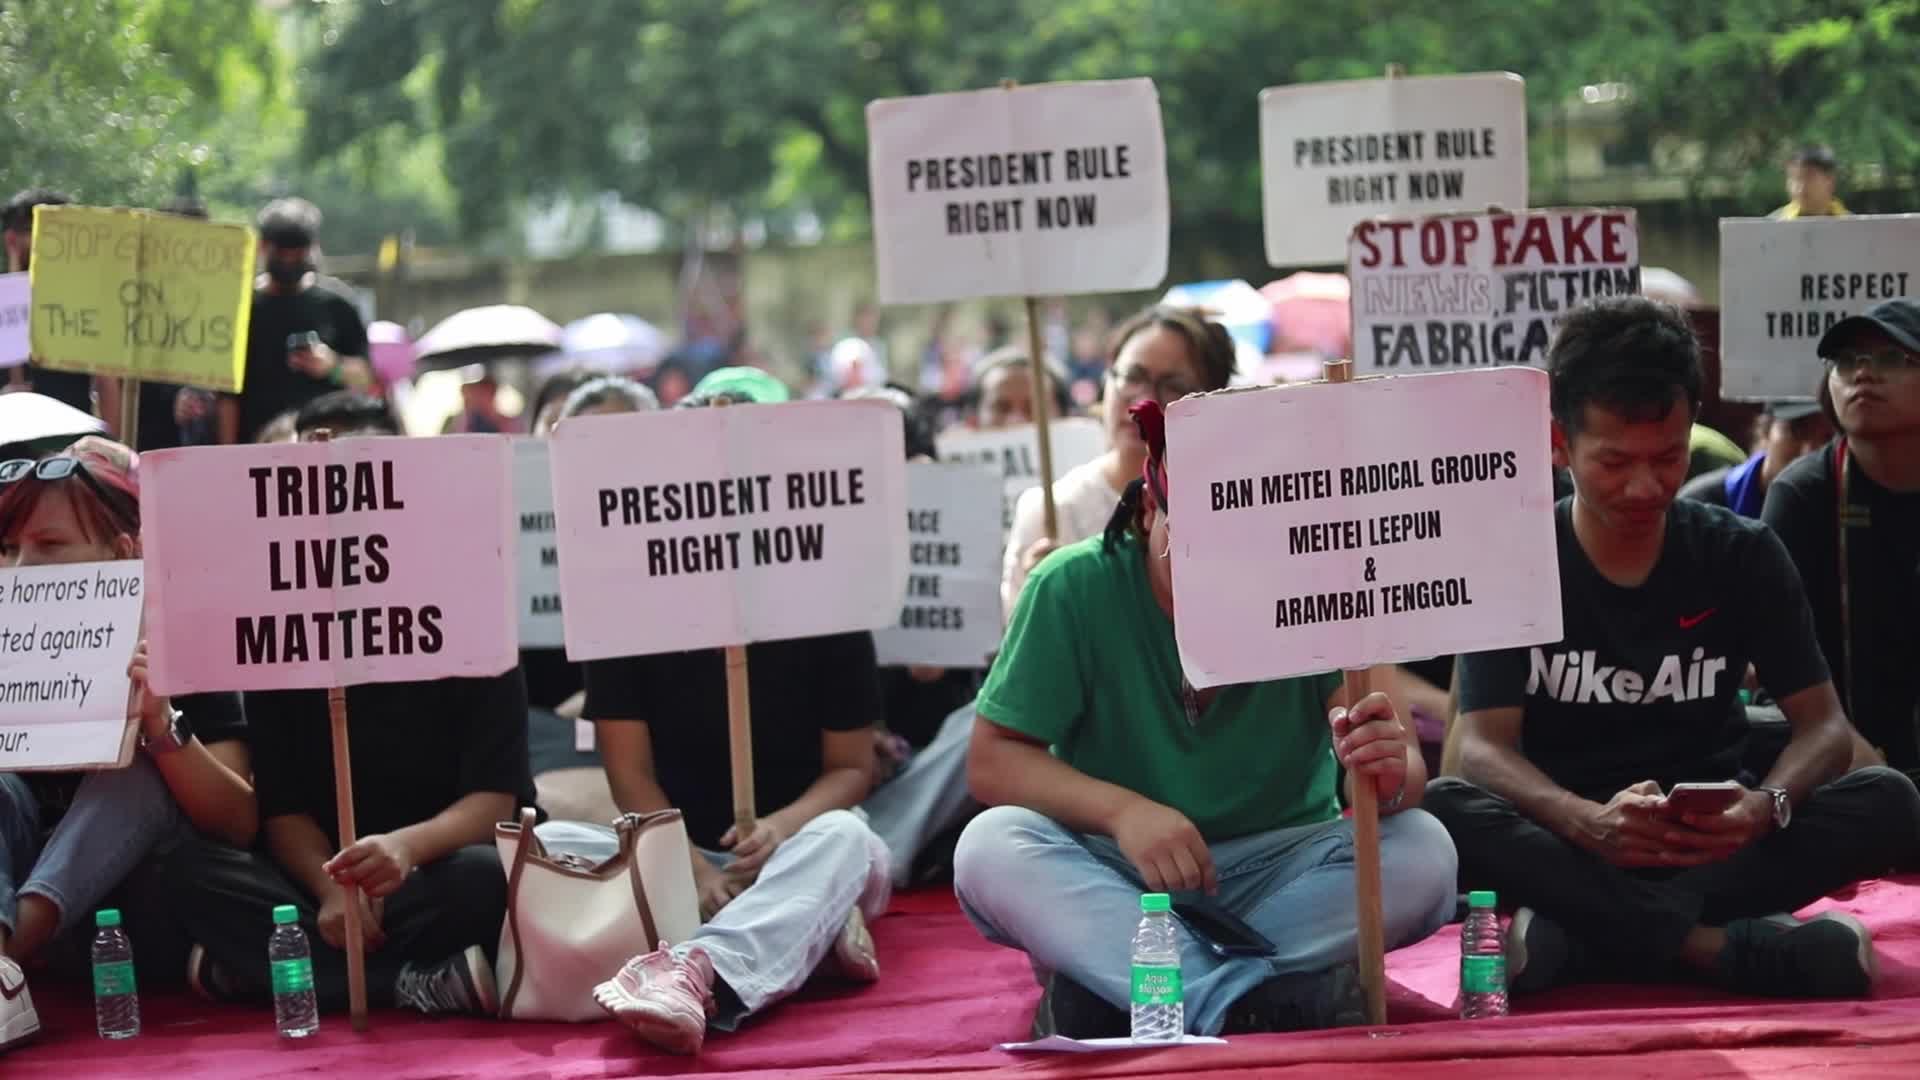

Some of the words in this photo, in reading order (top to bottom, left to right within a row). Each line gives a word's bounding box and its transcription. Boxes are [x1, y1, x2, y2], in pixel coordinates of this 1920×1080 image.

[1294, 131, 1426, 166] PRESIDENT
[1437, 127, 1497, 160] RULE
[907, 151, 1054, 192] PRESIDENT
[1066, 145, 1131, 181] RULE
[1328, 175, 1397, 204] RIGHT
[1409, 170, 1464, 199] NOW
[946, 198, 1024, 236] RIGHT
[1037, 194, 1097, 229] NOW
[39, 222, 112, 264] STOP
[1358, 218, 1478, 267] STOP
[1492, 214, 1628, 265] FAKE
[119, 279, 165, 310] ON
[1801, 272, 1909, 301] RESPECT
[39, 303, 101, 338] THE
[1371, 318, 1556, 367] FABRICA
[249, 460, 404, 518] TRIBAL
[599, 475, 771, 527] PRESIDENT
[787, 468, 865, 510] RULE
[1210, 478, 1254, 511] BAN
[1261, 468, 1332, 505] MEITEI
[1340, 460, 1424, 496] RADICAL
[1431, 451, 1518, 485] GROUPS
[647, 532, 741, 577] RIGHT
[753, 524, 825, 566] NOW
[1288, 520, 1362, 555] MEITEI
[1369, 510, 1442, 546] LEEPUN
[269, 533, 390, 592] LIVES
[910, 542, 961, 566] CERS
[1364, 557, 1377, 582] &
[11, 575, 89, 604] horrors
[94, 569, 140, 599] have
[1275, 589, 1375, 628] ARAMBAI
[1381, 577, 1472, 615] TENGGOL
[235, 605, 443, 665] MATTERS
[901, 605, 964, 630] ORCES
[0, 623, 37, 652] ted
[40, 621, 114, 659] against
